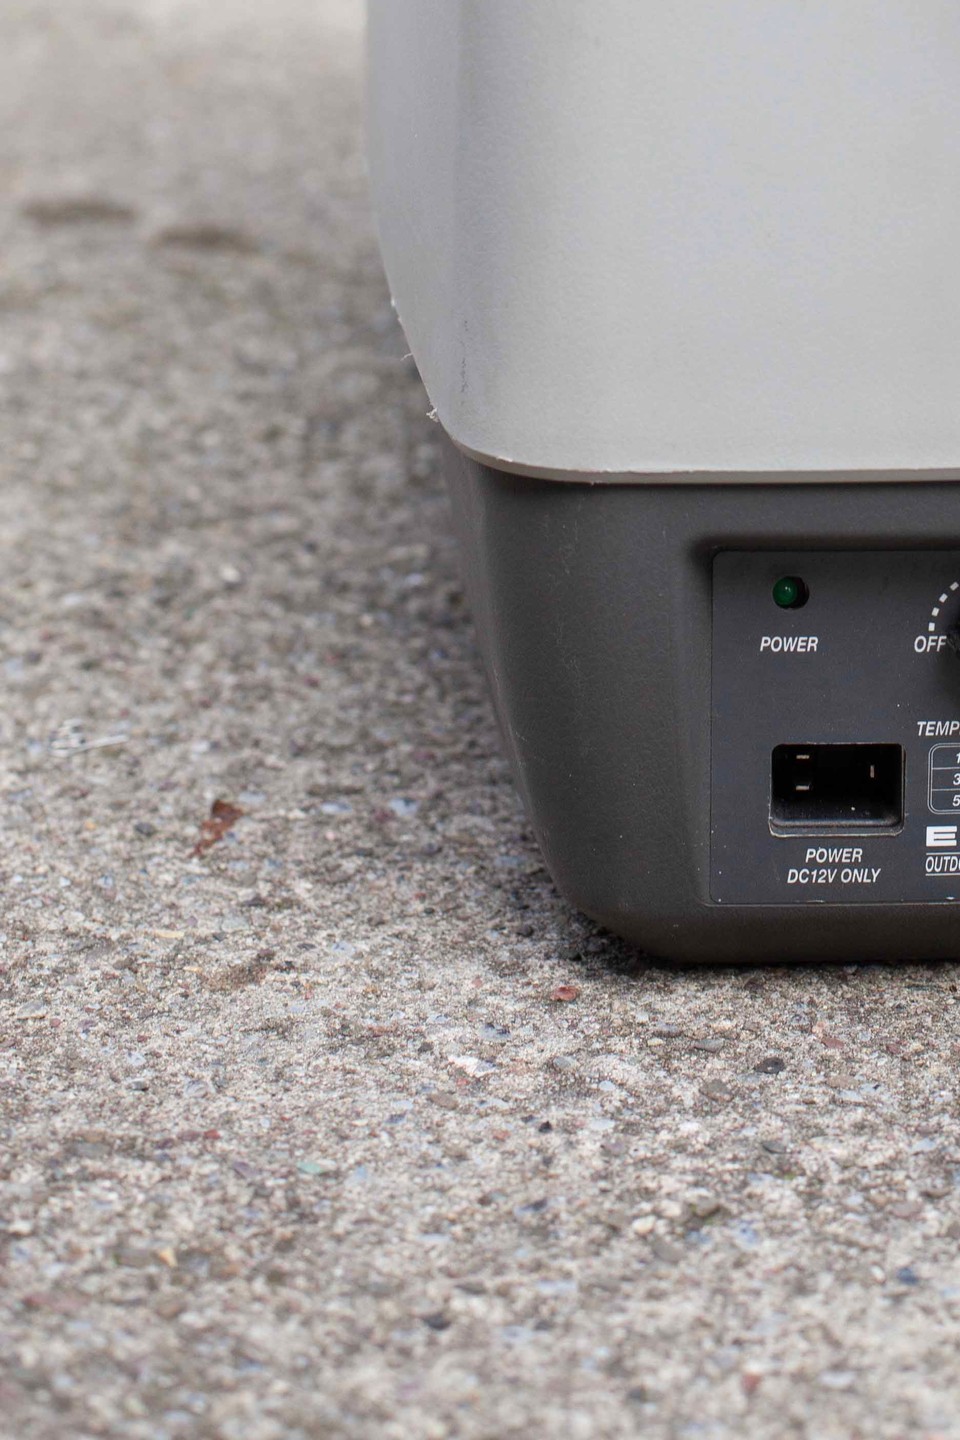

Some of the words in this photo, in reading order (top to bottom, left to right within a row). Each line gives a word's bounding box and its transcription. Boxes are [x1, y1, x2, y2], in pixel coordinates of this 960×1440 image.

[759, 636, 819, 653] POWER
[914, 635, 947, 653] OFF
[805, 848, 863, 863] POWER
[787, 868, 837, 884] DC12V
[841, 868, 881, 884] ONLY
